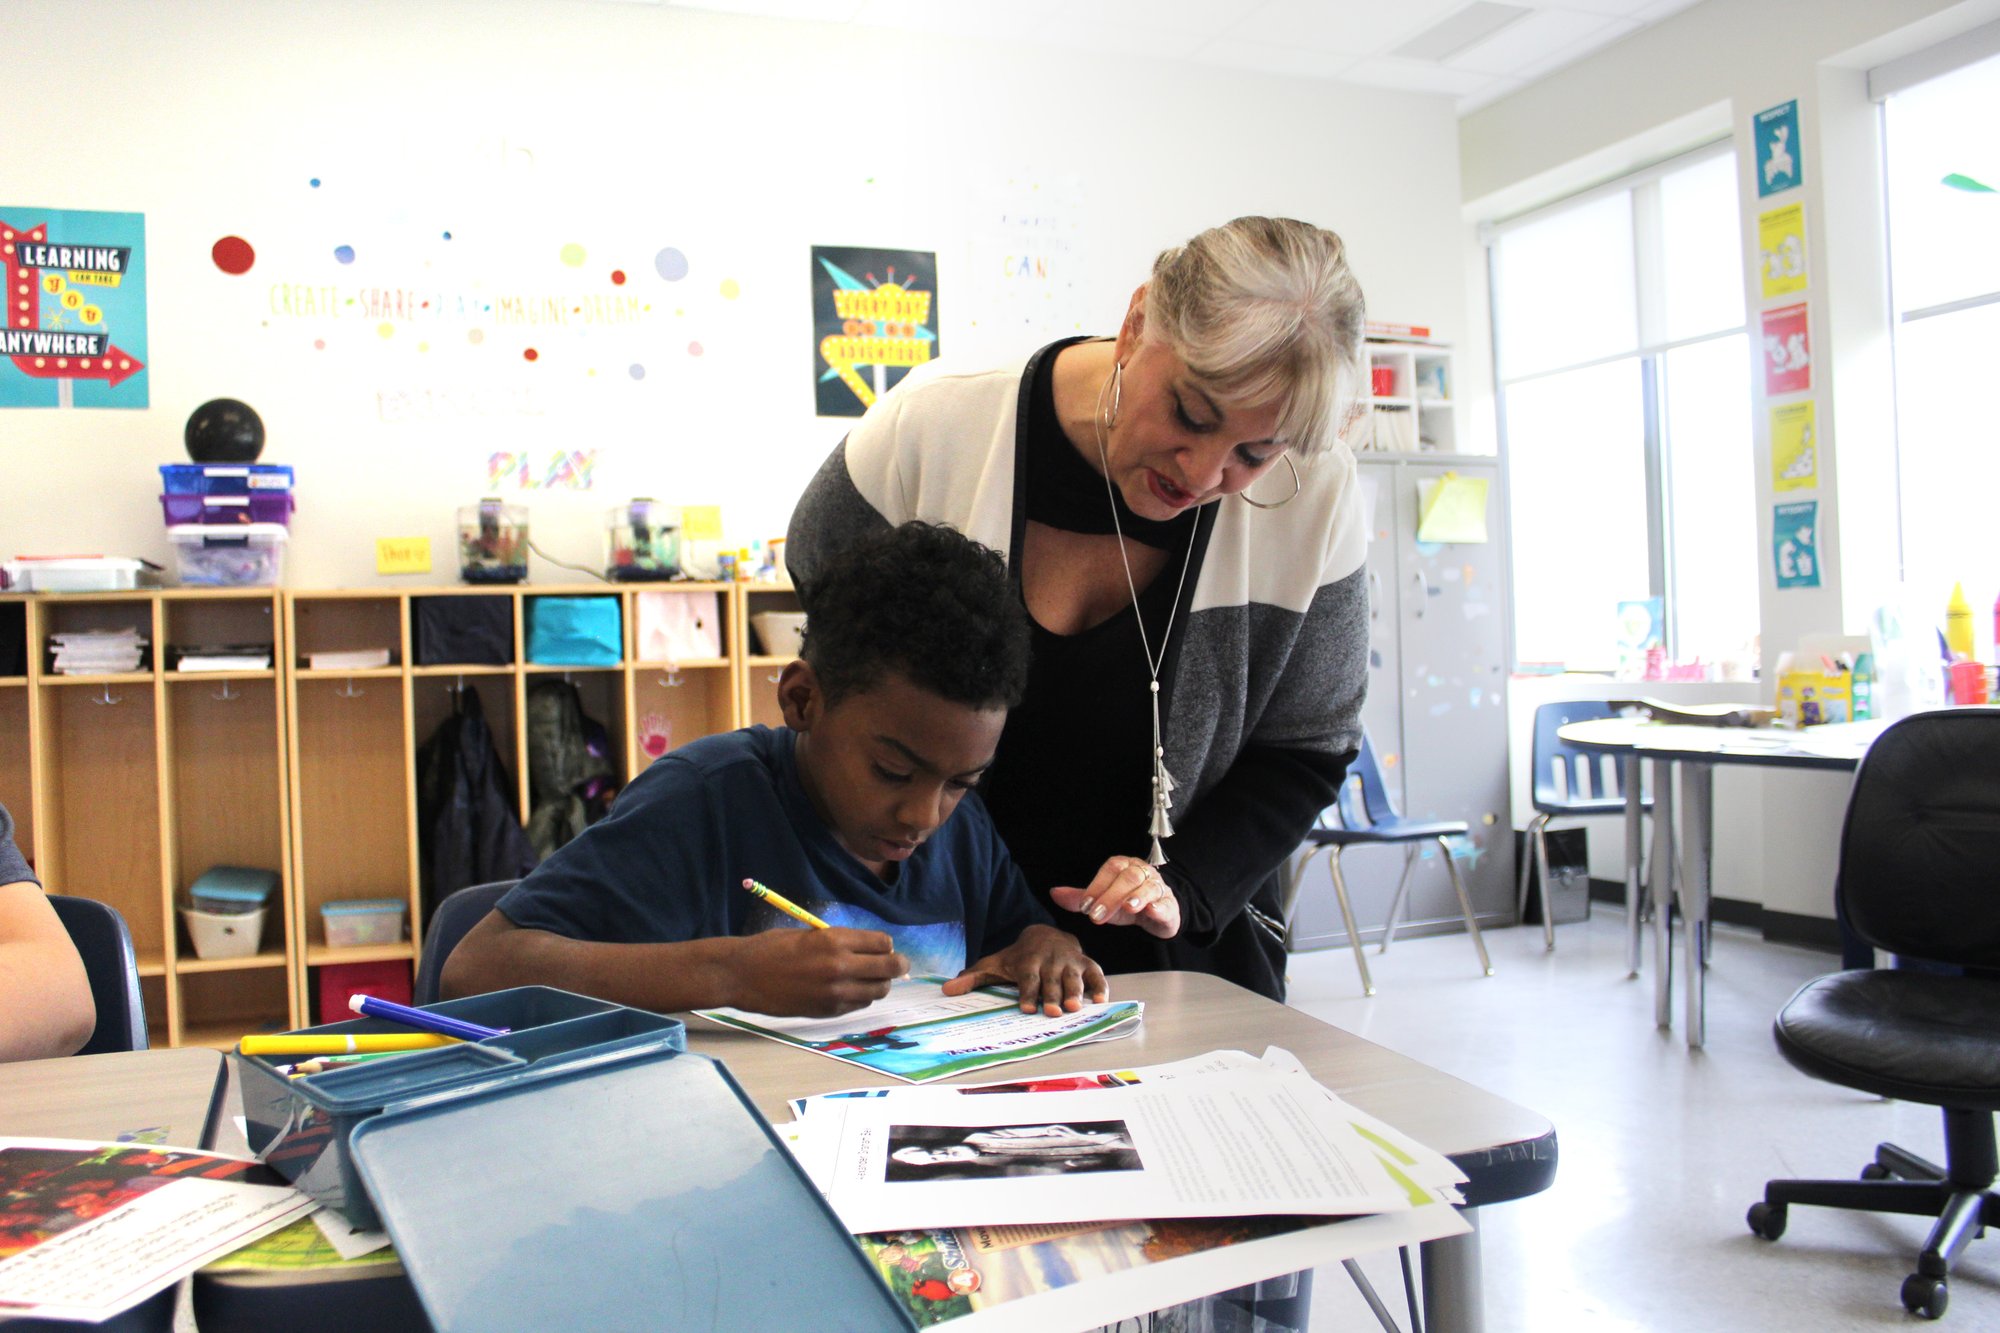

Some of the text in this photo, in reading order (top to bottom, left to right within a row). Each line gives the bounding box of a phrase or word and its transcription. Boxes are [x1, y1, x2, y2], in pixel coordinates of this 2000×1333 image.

[25, 246, 121, 272] LEARNING
[269, 282, 341, 319] CREATE
[360, 288, 415, 321] SHARE
[495, 296, 569, 326] IMAGINE
[582, 294, 641, 325] DREAM
[0, 331, 98, 355] ANYWHERE
[488, 449, 596, 490] PLAY
[946, 1044, 1000, 1056] Way
[999, 1030, 1061, 1046] Write
